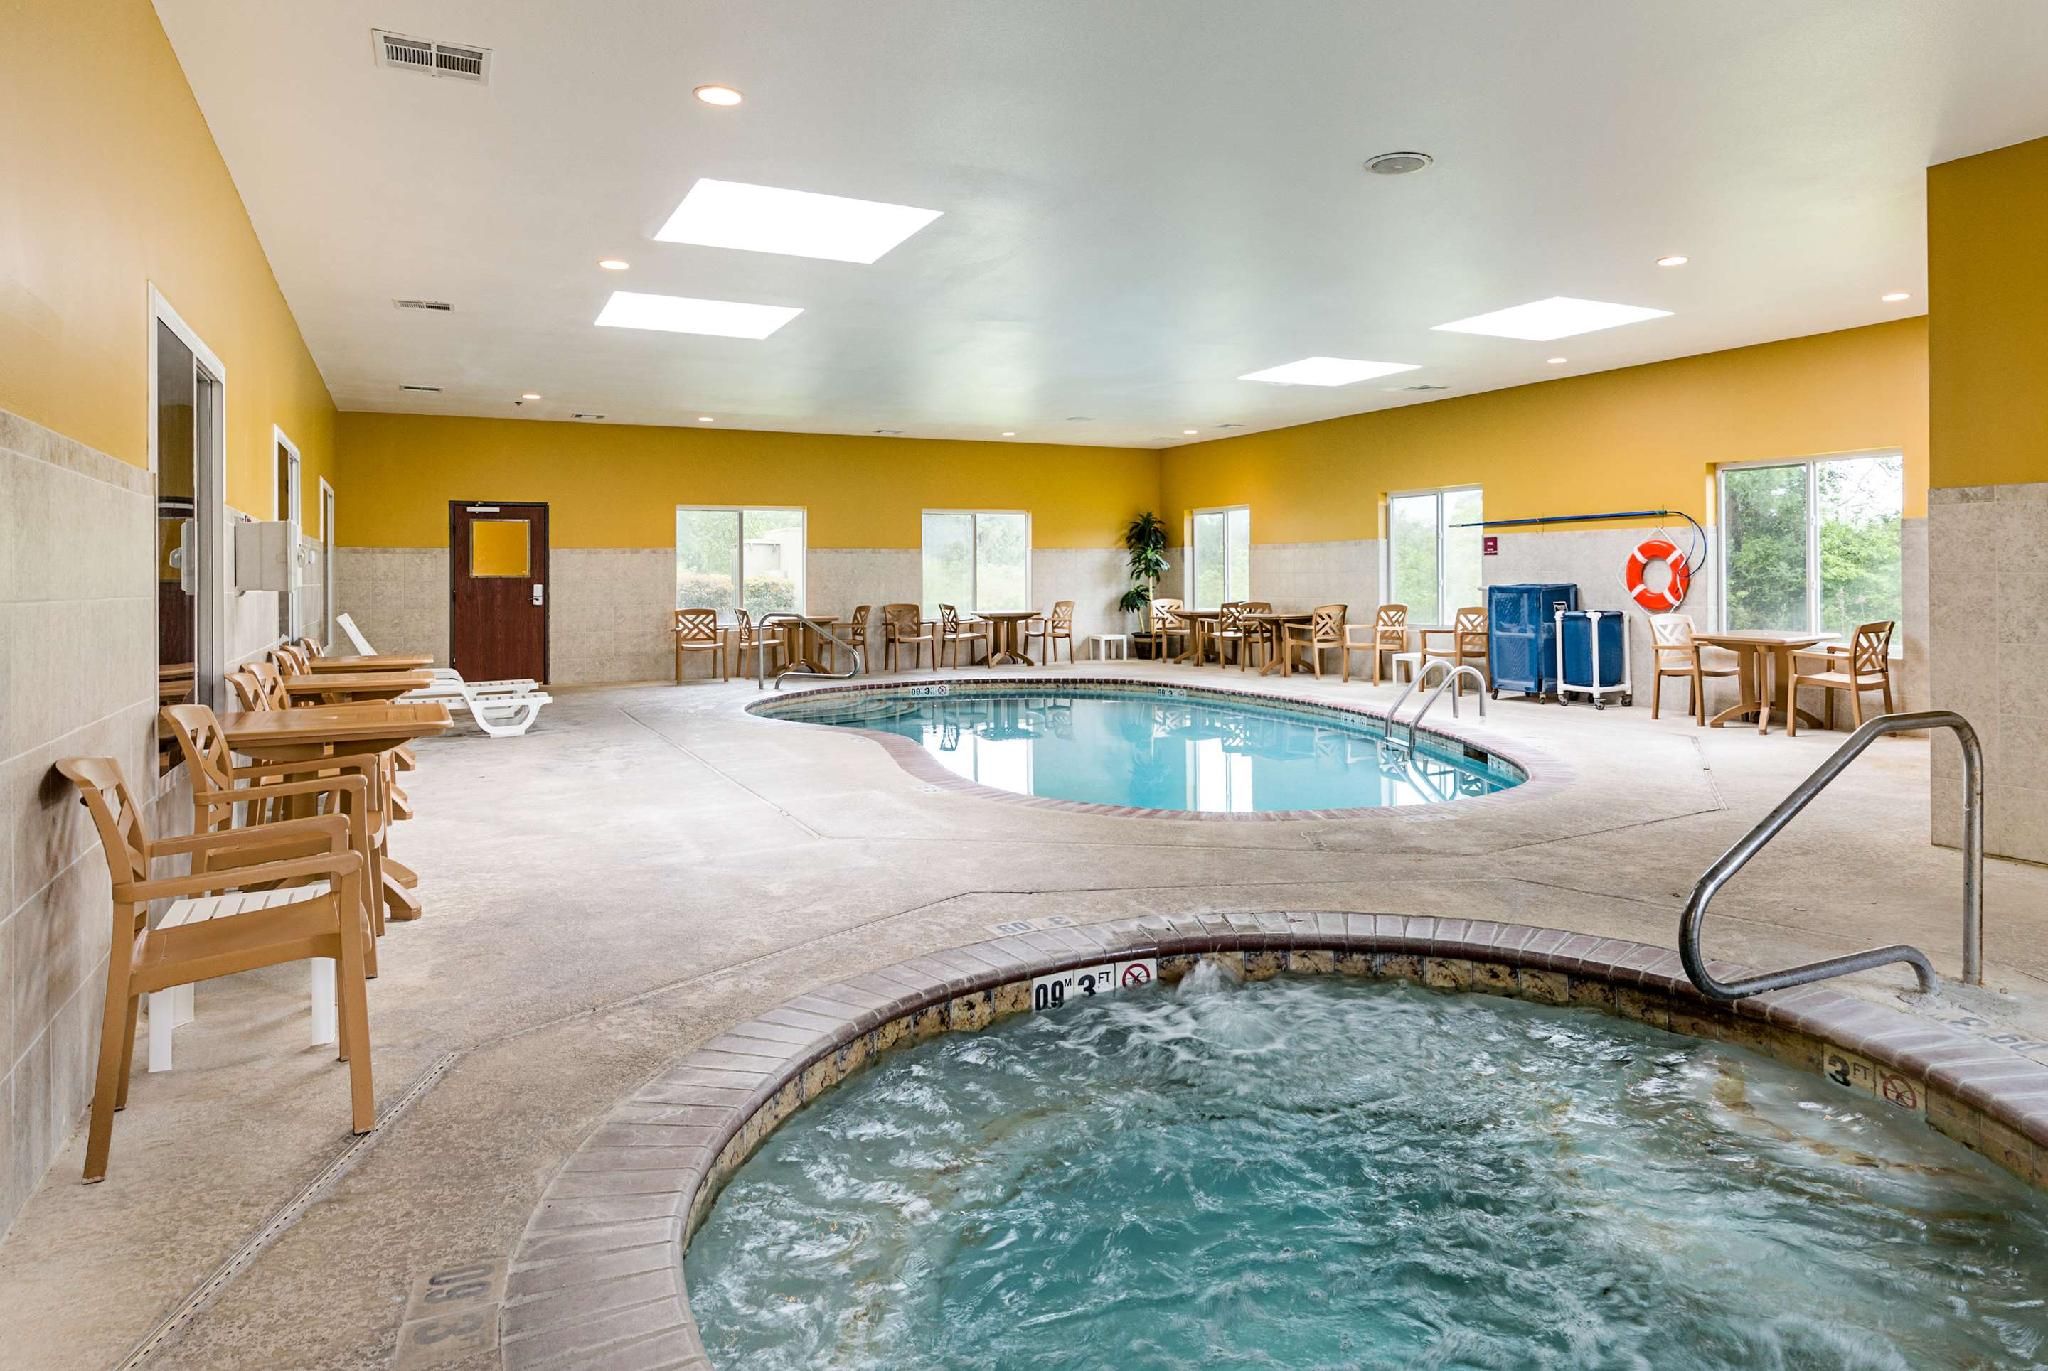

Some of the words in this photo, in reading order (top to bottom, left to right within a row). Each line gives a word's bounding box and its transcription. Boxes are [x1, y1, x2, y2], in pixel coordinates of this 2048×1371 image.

[1098, 971, 1111, 984] FT
[1828, 1054, 1852, 1088] 3
[1852, 1062, 1870, 1081] FT
